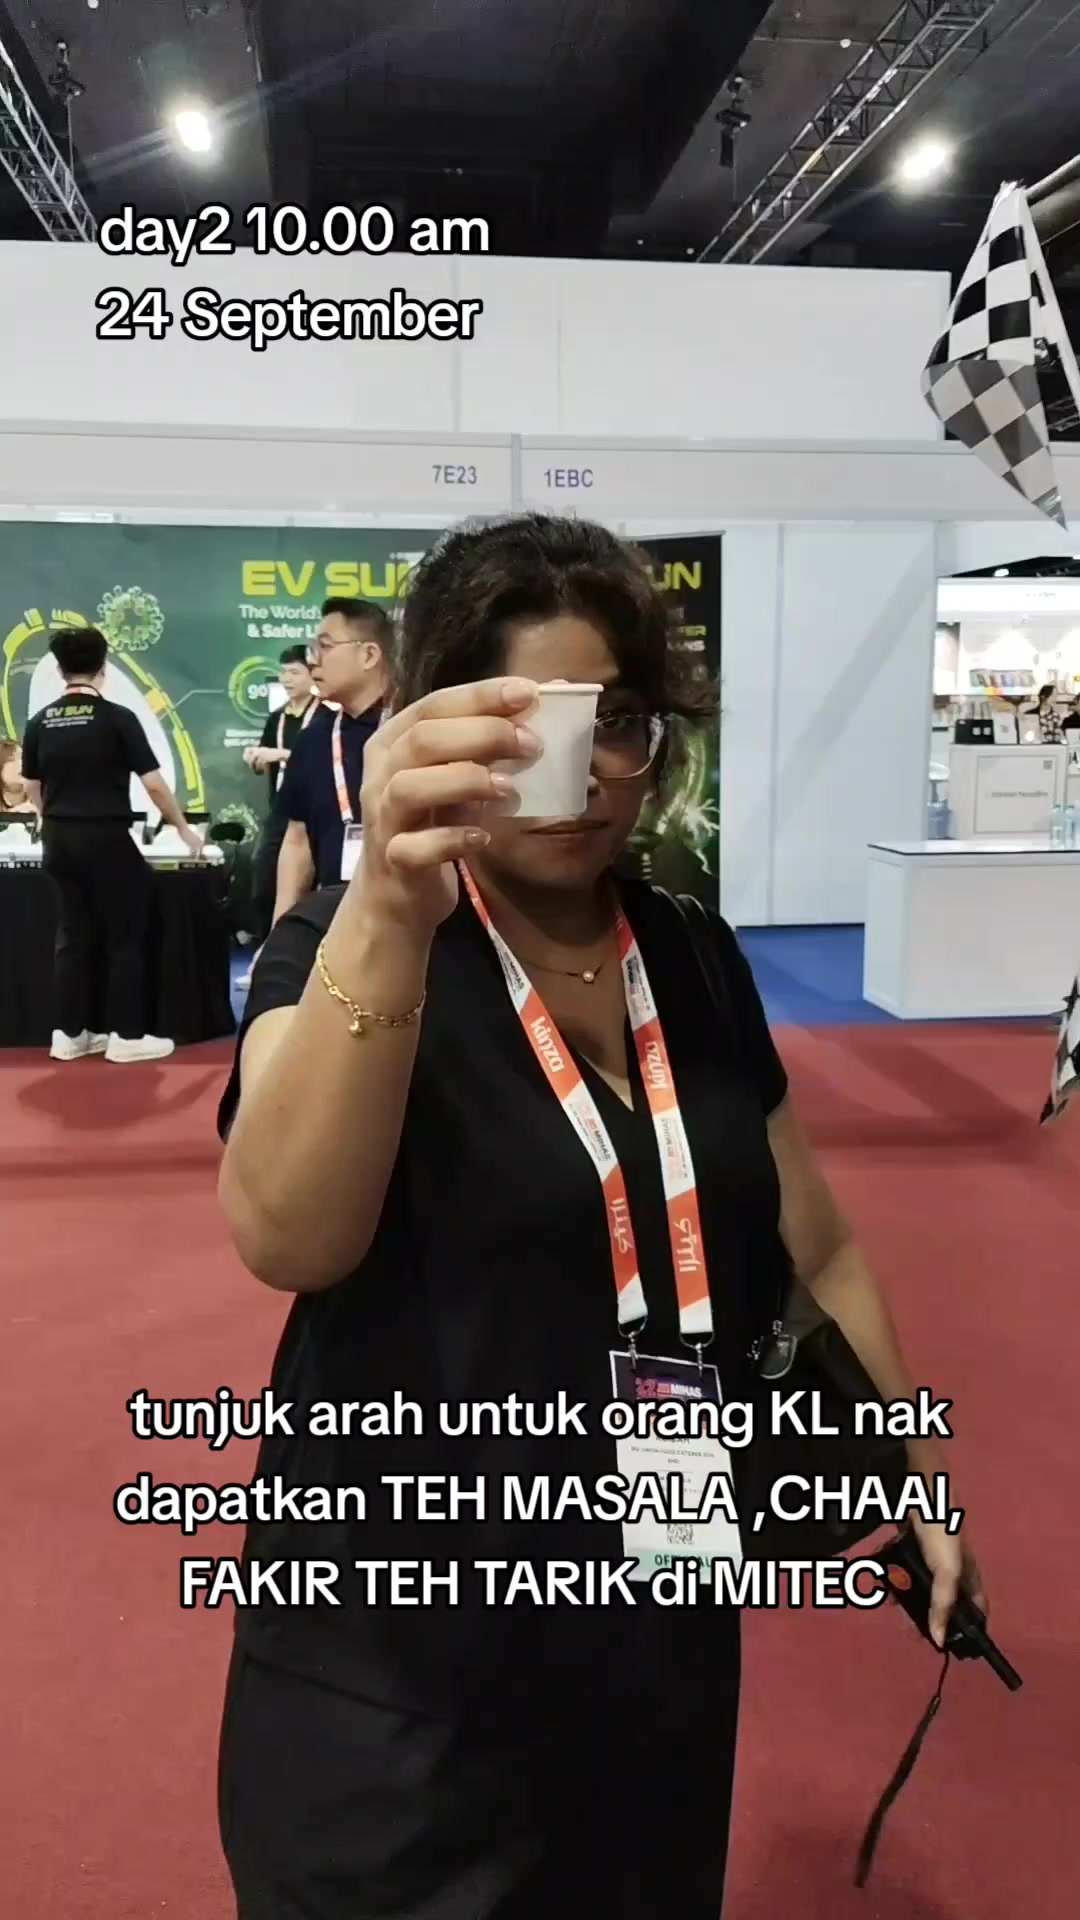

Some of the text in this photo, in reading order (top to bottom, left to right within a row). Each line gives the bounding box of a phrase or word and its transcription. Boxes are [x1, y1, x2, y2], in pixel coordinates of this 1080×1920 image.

[431, 464, 478, 485] 7E23
[543, 468, 594, 488] 1EBC
[242, 560, 316, 597] EV
[238, 604, 268, 619] The
[247, 624, 261, 638] &
[262, 624, 303, 638] Safer
[64, 704, 95, 716] SUN
[530, 1015, 565, 1073] kinza
[646, 1040, 669, 1090] kinza
[670, 1383, 702, 1398] MIHAS
